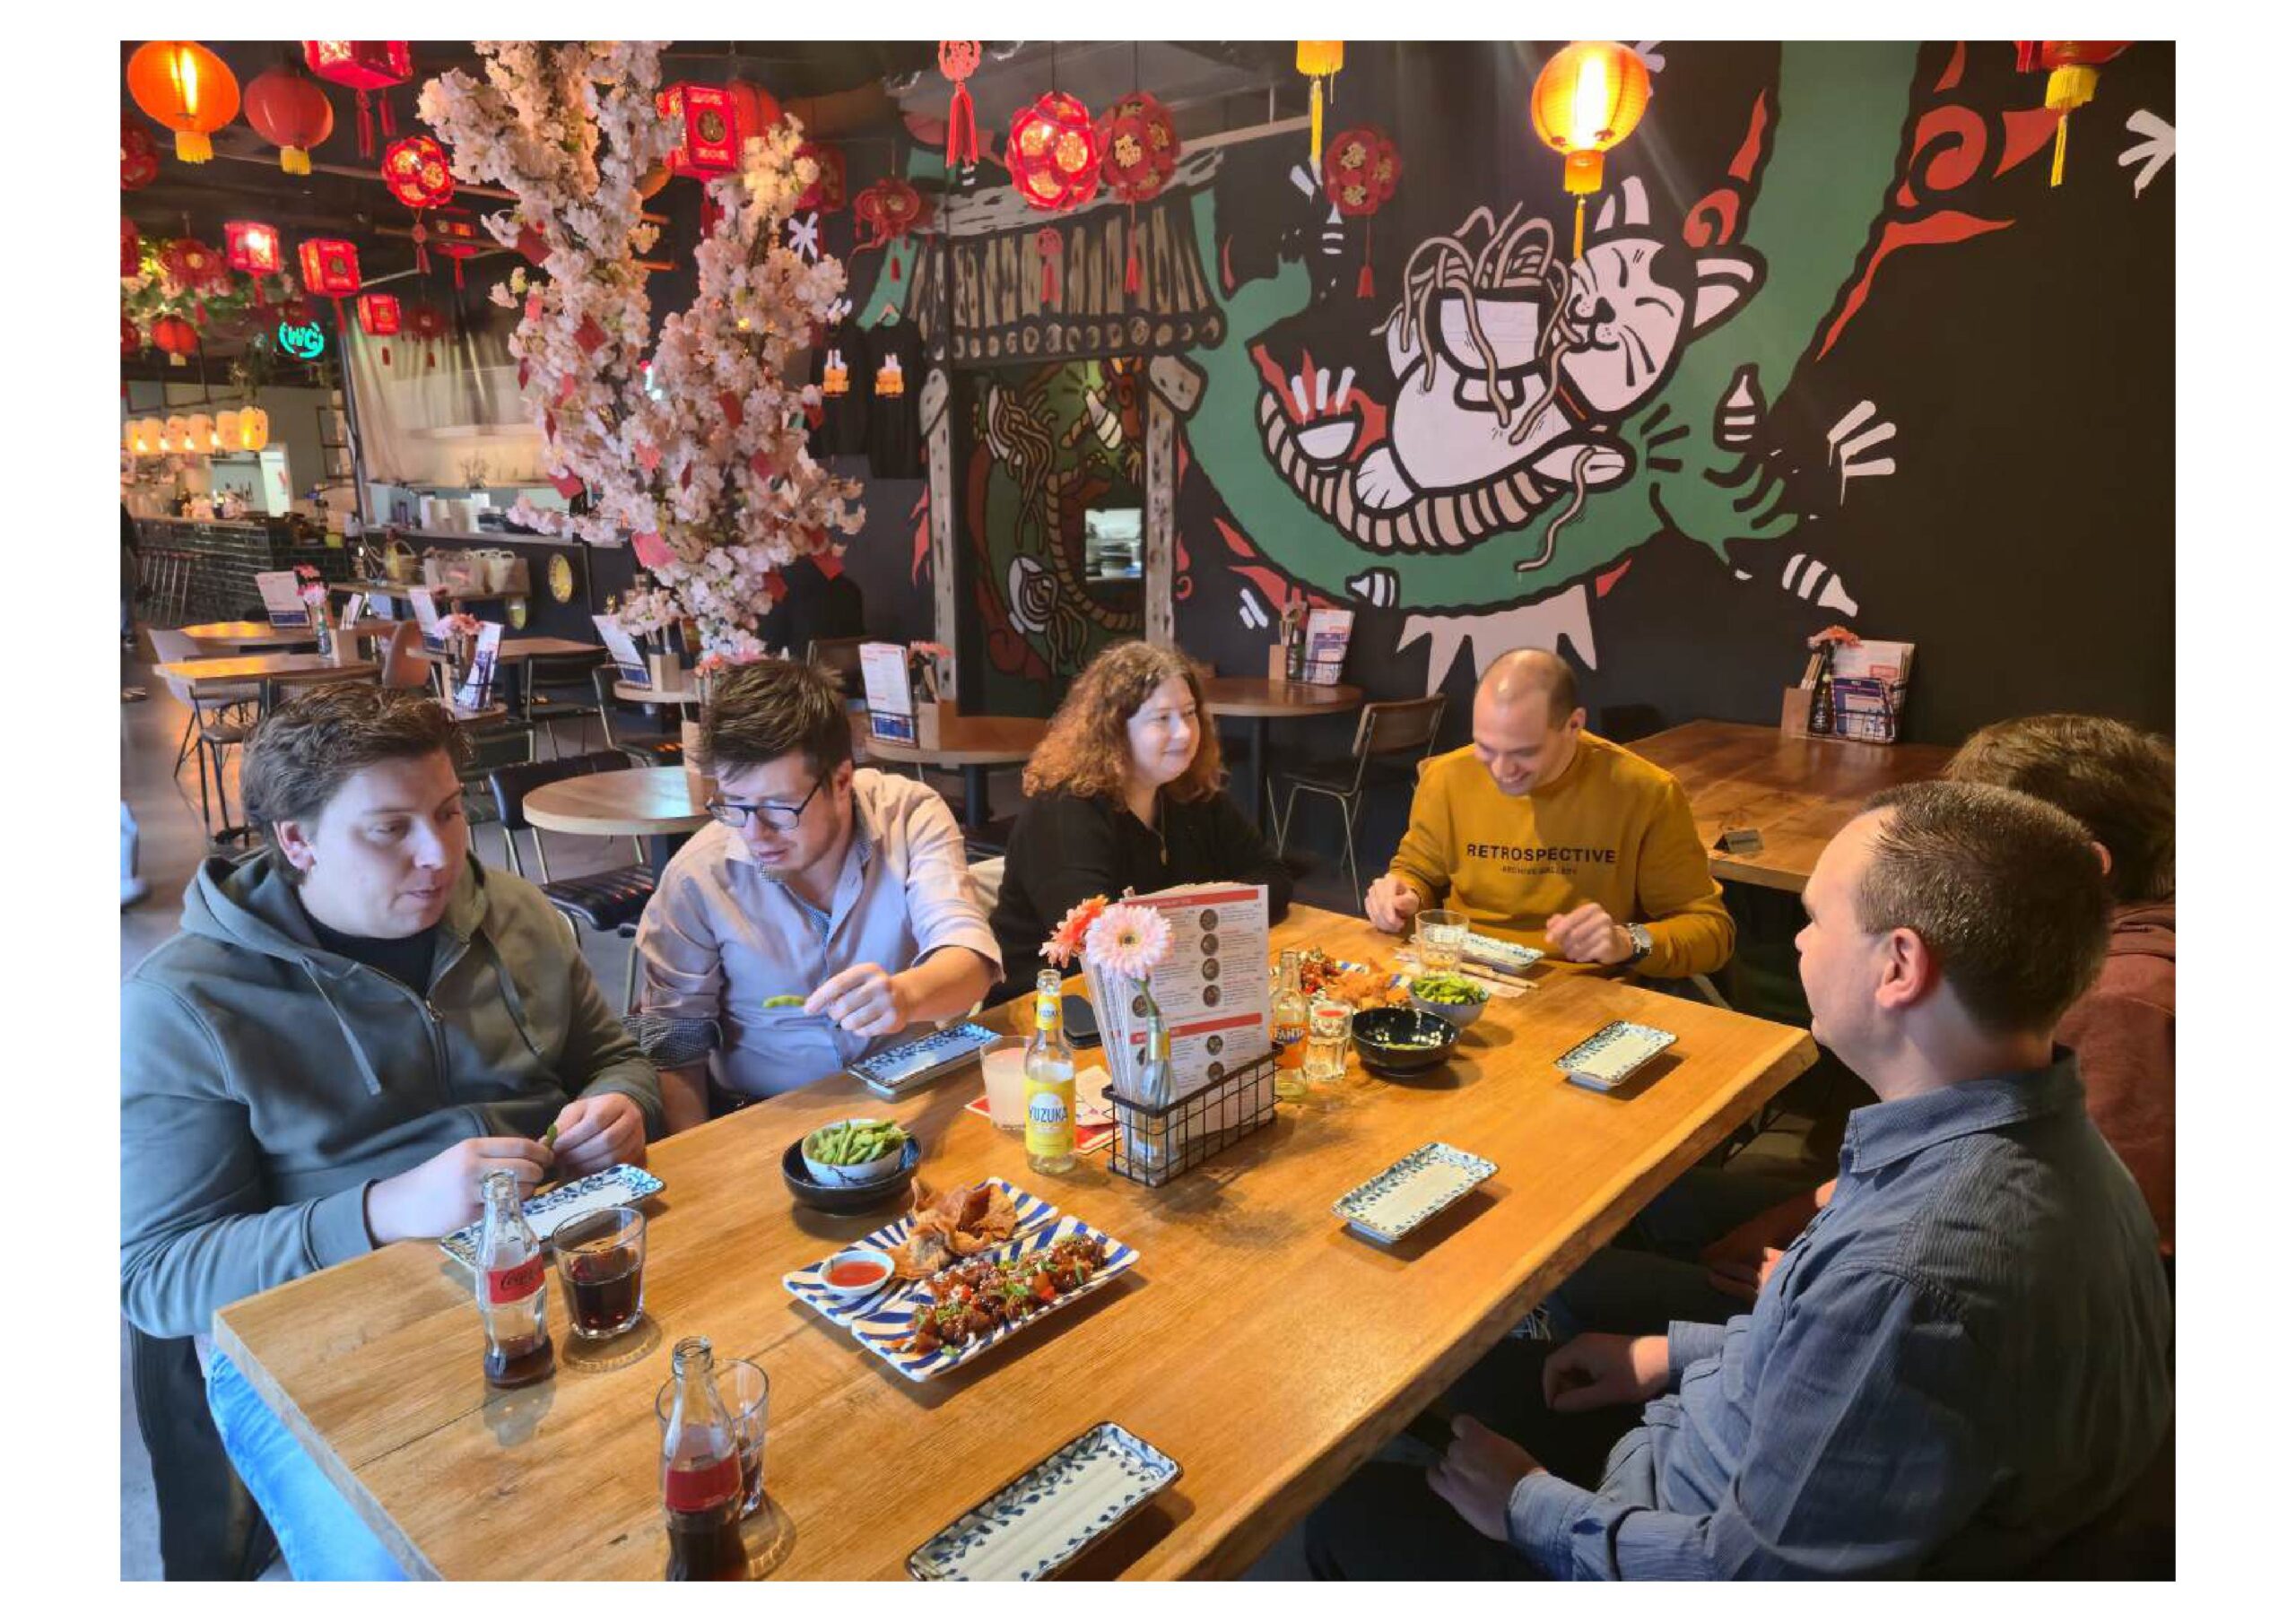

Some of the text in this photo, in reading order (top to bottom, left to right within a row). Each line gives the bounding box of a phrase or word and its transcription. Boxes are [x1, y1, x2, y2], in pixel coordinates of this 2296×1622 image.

[288, 326, 318, 350] WC
[1465, 844, 1617, 863] RETROSPECTIVE
[1028, 1105, 1068, 1123] YUZUKA
